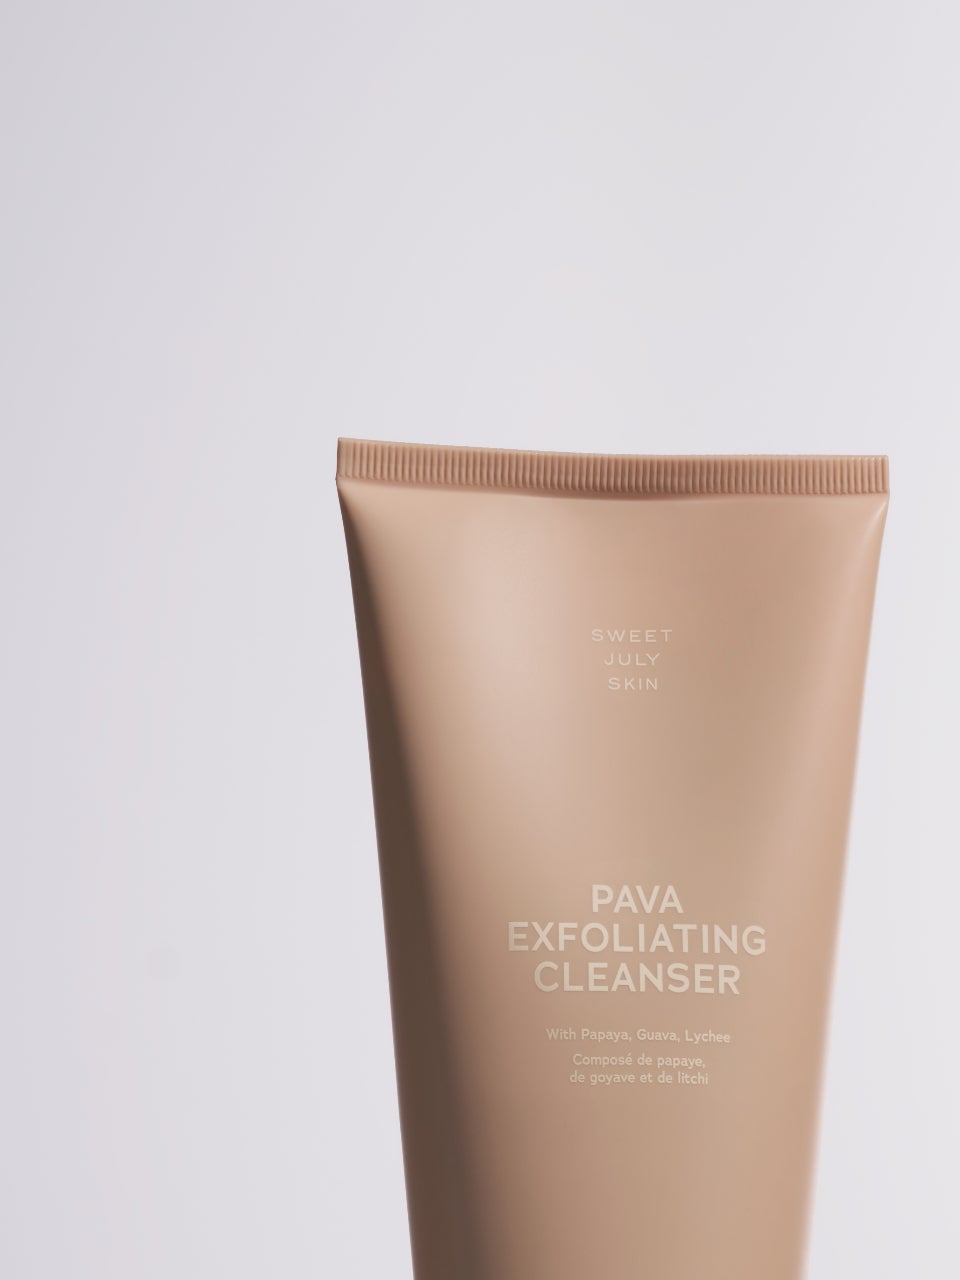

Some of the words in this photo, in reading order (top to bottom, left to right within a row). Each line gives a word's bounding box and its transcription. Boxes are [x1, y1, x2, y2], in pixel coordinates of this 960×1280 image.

[590, 629, 673, 643] SWEET
[604, 652, 660, 666] JULY
[607, 677, 659, 691] SKIN
[591, 884, 684, 914] PAVA
[507, 922, 767, 955] EXFOLIATING
[533, 961, 741, 995] CLEANSER
[545, 1028, 577, 1041] With
[581, 1028, 632, 1043] Papaya,
[636, 1029, 681, 1043] Guava,
[685, 1030, 731, 1044] Lychee
[572, 1053, 633, 1068] Composé
[637, 1054, 653, 1066] de
[657, 1057, 706, 1069] papaye,
[569, 1070, 585, 1083] de
[590, 1073, 636, 1086] goyave
[640, 1073, 653, 1083] et
[657, 1071, 673, 1084] de
[677, 1071, 709, 1085] litchi
